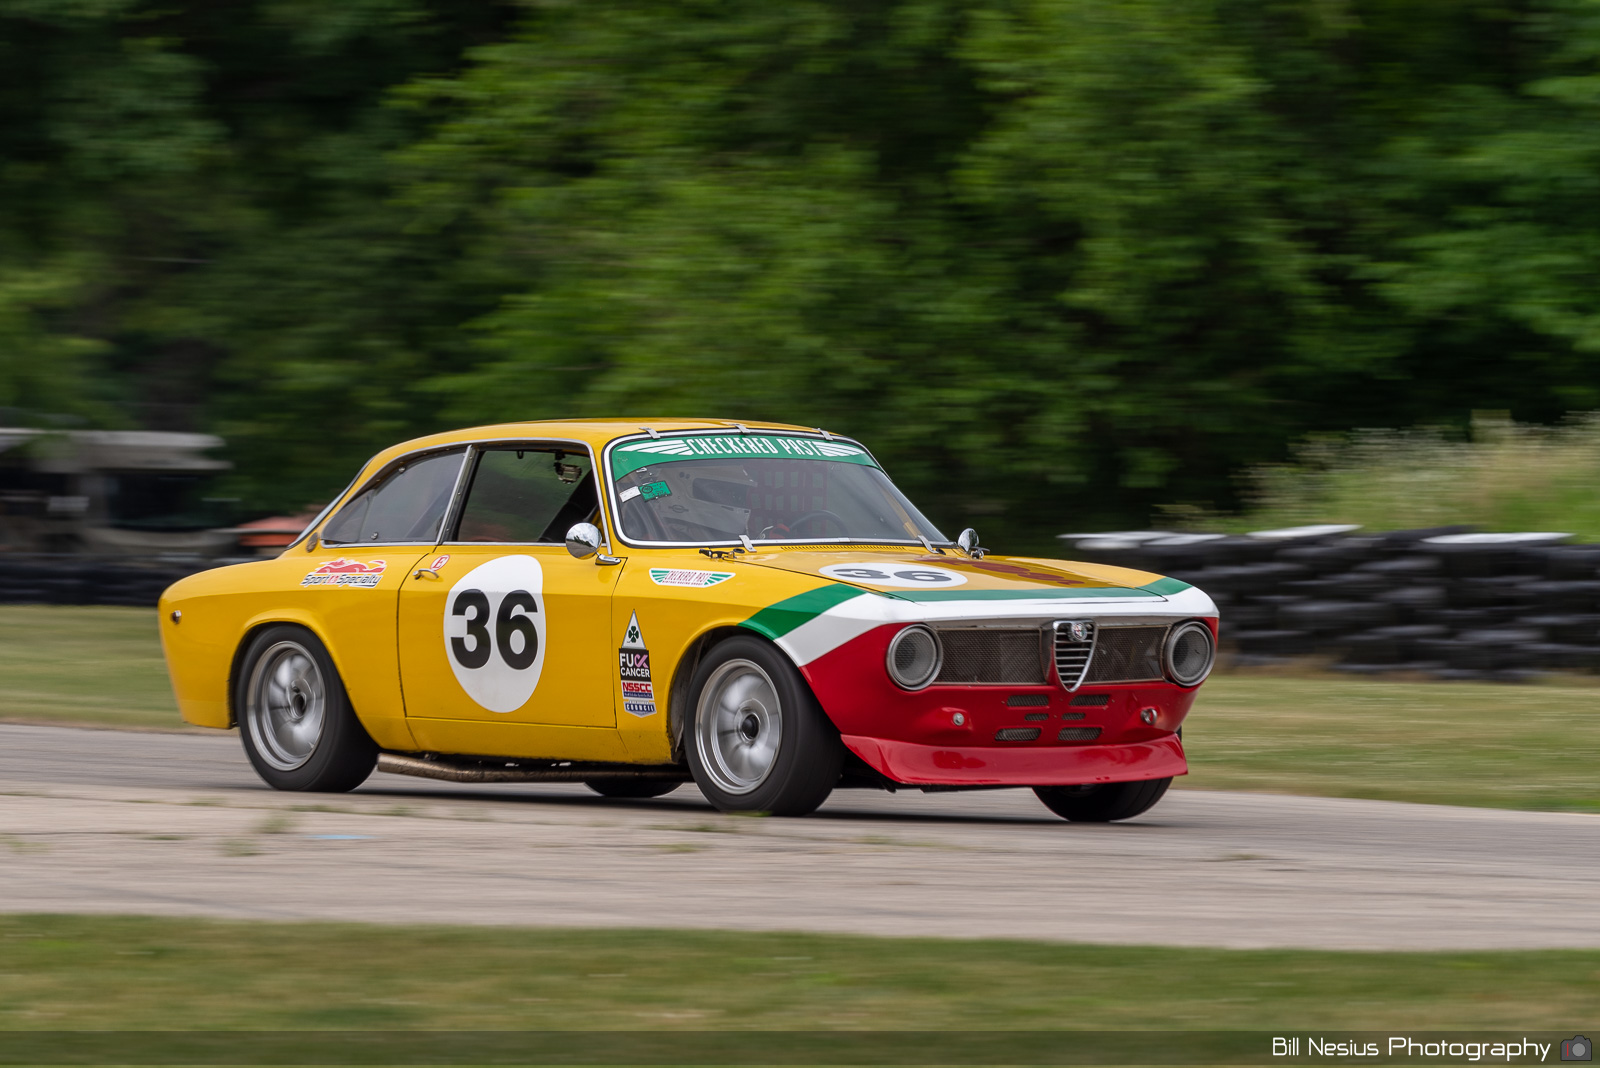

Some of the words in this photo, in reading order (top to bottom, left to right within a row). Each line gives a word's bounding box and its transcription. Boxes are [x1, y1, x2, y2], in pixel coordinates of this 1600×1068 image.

[686, 438, 779, 456] CHECKERED
[779, 438, 822, 457] PAST
[301, 574, 329, 586] Sport
[337, 574, 382, 586] Specialty
[832, 568, 952, 582] 36
[450, 588, 539, 671] 36
[620, 667, 650, 677] CANCER
[622, 682, 652, 693] NSSCC
